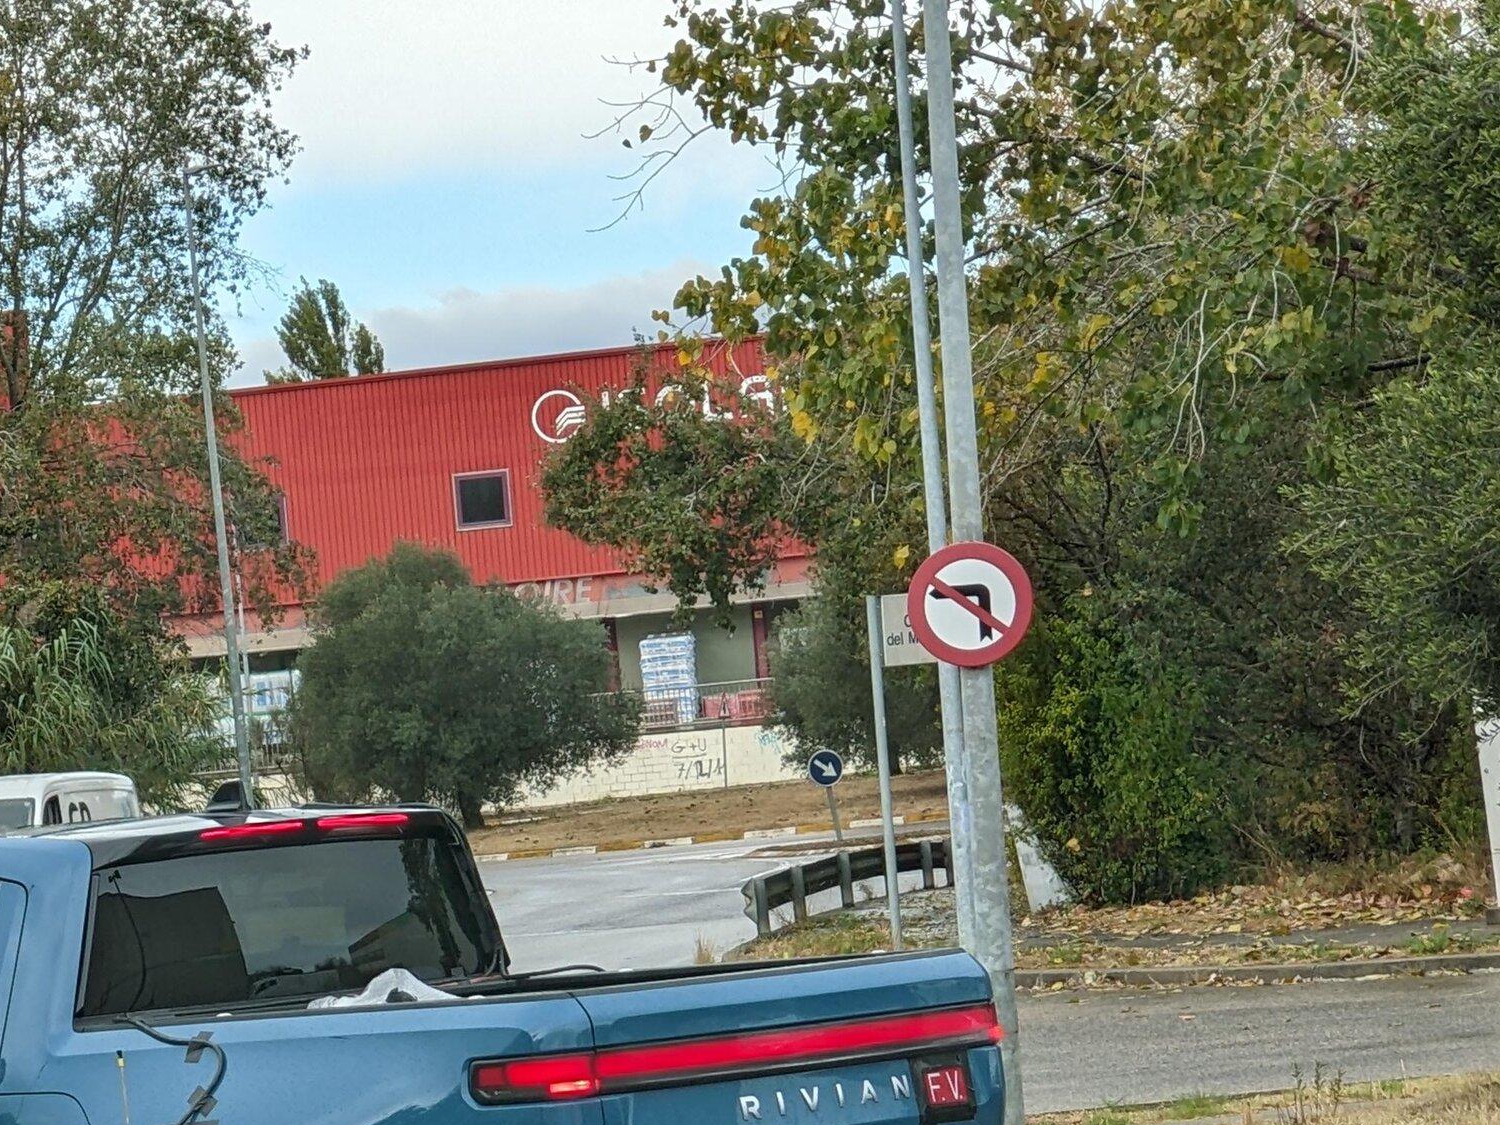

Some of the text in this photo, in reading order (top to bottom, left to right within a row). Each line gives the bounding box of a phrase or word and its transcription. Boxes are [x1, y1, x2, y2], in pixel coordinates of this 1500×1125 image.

[886, 632, 904, 646] del
[739, 1073, 911, 1121] RIVIAN
[926, 1069, 964, 1103] F.V.
